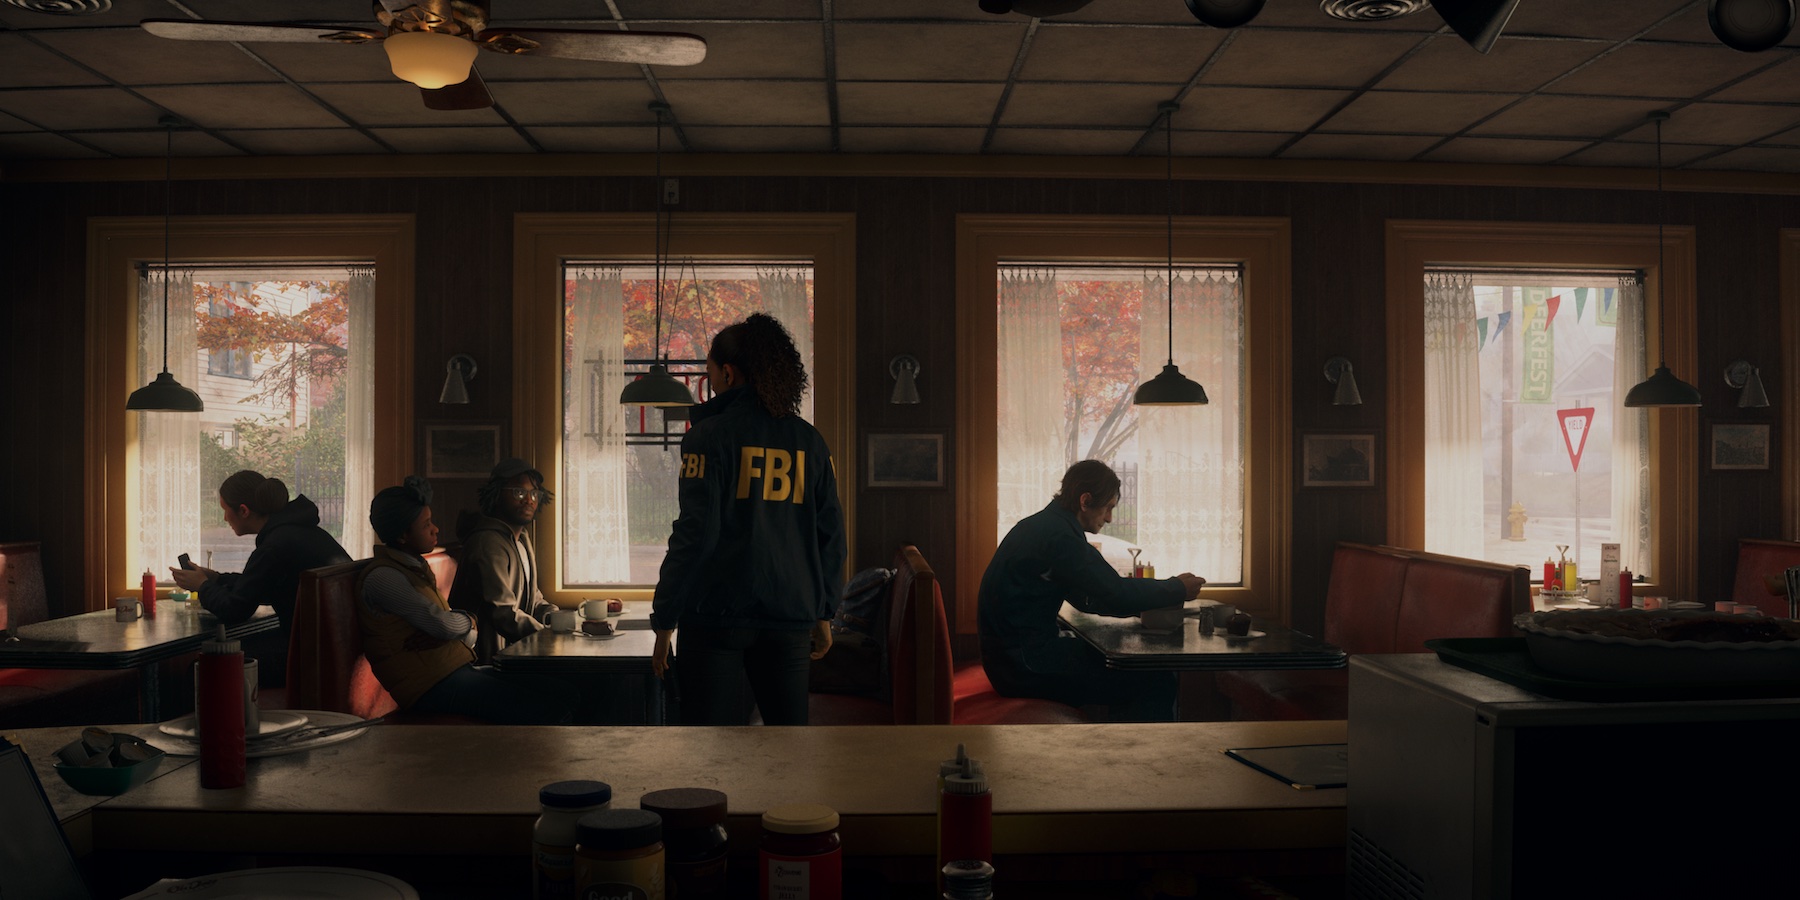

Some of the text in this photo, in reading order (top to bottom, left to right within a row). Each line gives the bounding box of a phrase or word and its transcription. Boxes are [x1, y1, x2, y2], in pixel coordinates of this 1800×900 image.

[1529, 289, 1548, 395] DEERFEST
[680, 453, 706, 479] FBI
[736, 446, 806, 505] FBI
